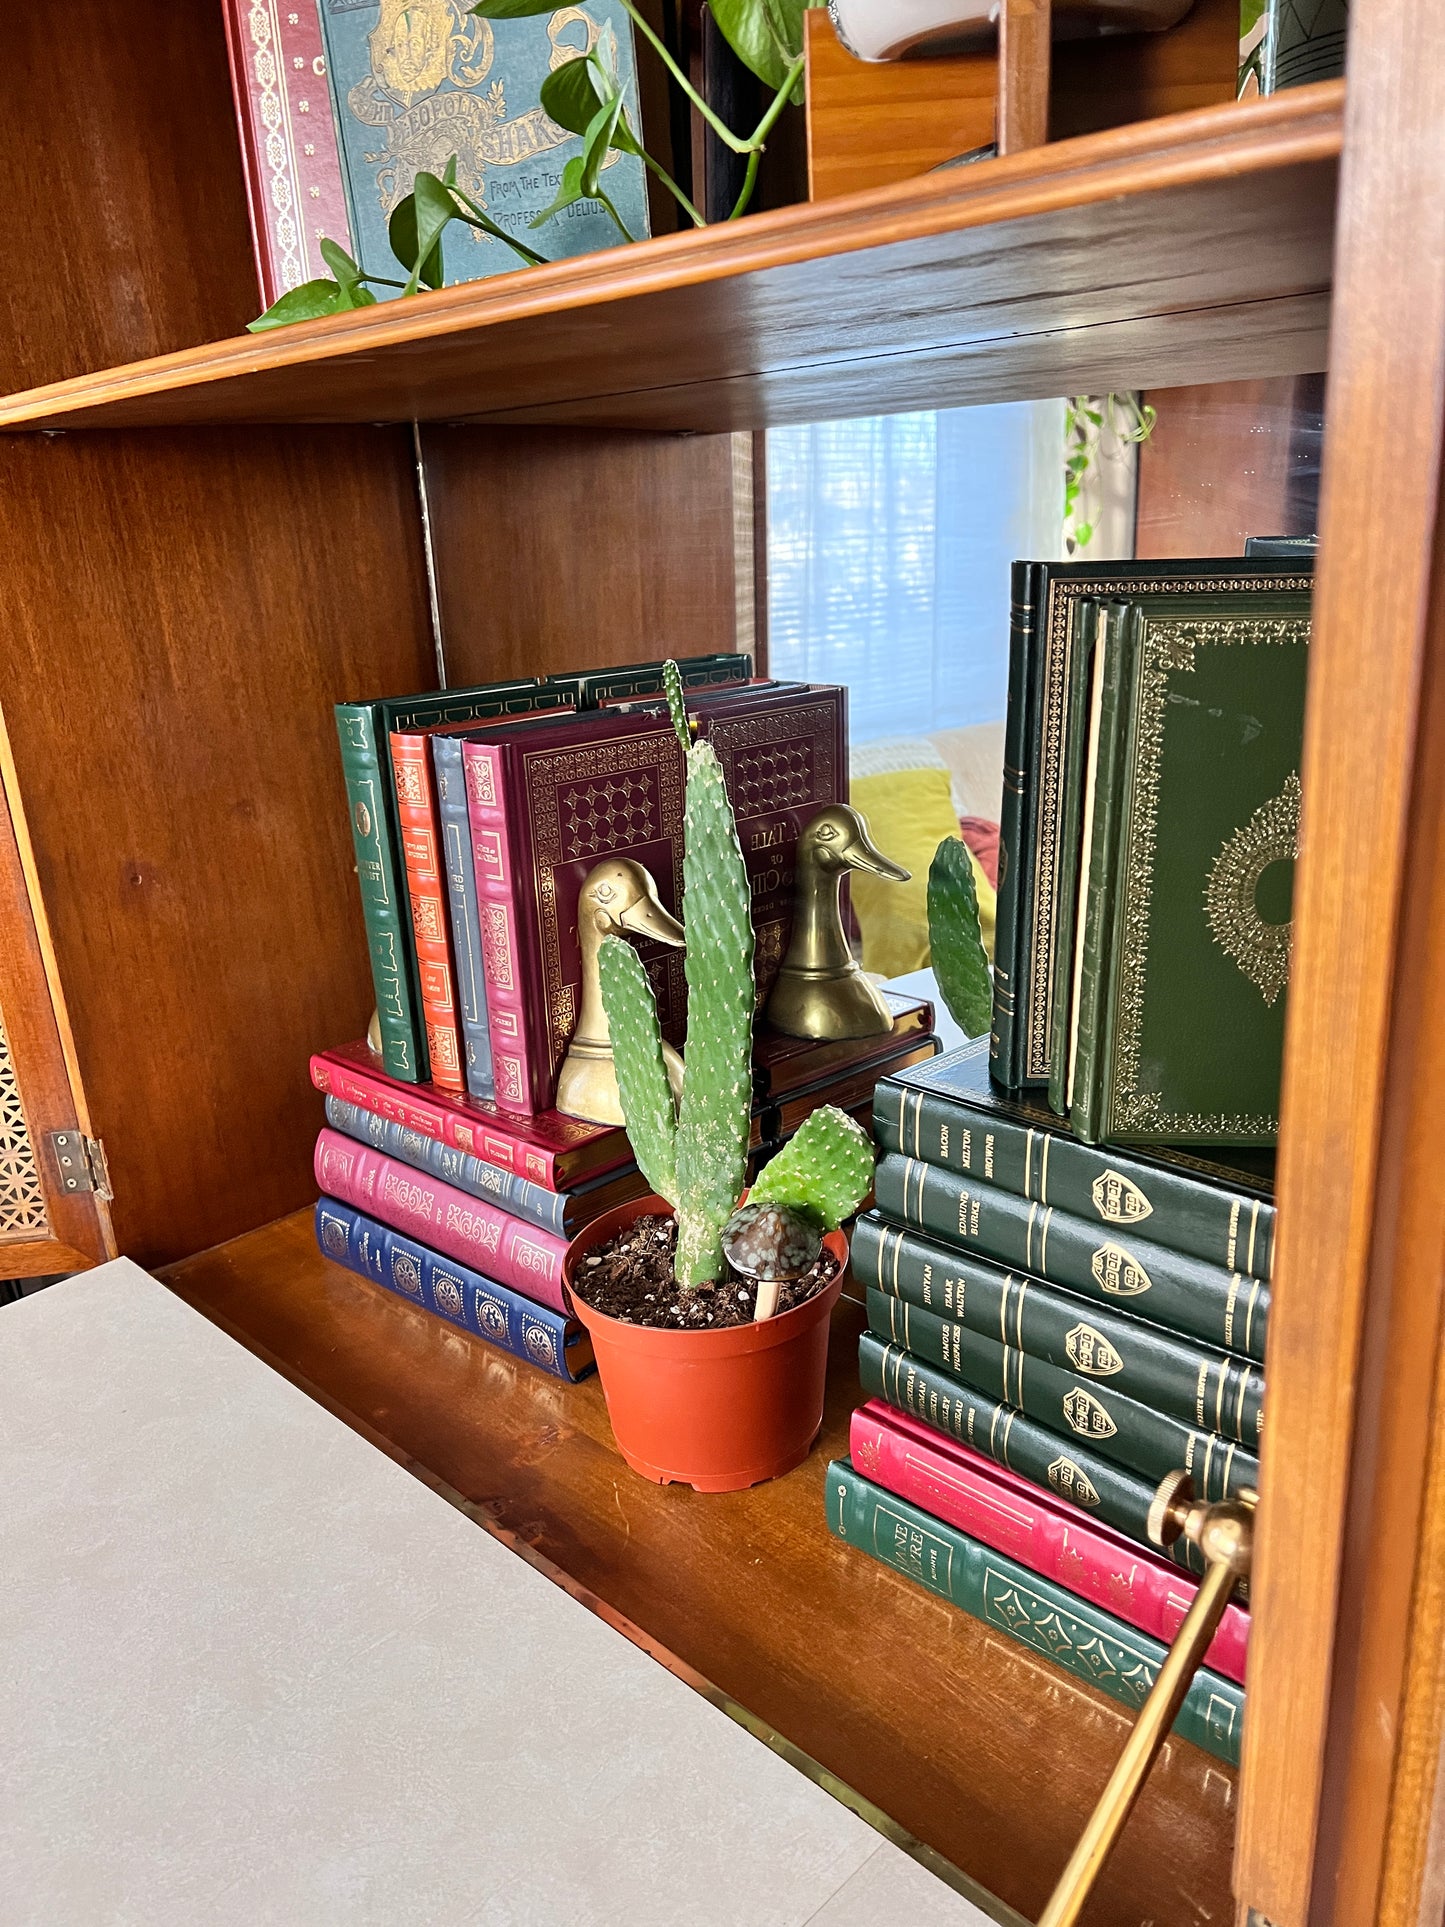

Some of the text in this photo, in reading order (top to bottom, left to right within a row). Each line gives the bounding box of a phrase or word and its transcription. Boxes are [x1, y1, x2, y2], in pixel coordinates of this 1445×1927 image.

[490, 172, 564, 201] FROM THE TEX
[941, 1123, 949, 1158] BACON
[963, 1128, 971, 1169] MILTON
[985, 1133, 994, 1179] BROWNE
[959, 1190, 969, 1236] EDMUND
[971, 1200, 980, 1236] BURKE
[923, 1264, 932, 1305] BUNYAN
[956, 1278, 965, 1318] WALTON
[942, 1324, 950, 1362] FAMOUS
[952, 1324, 961, 1373] PREFACES
